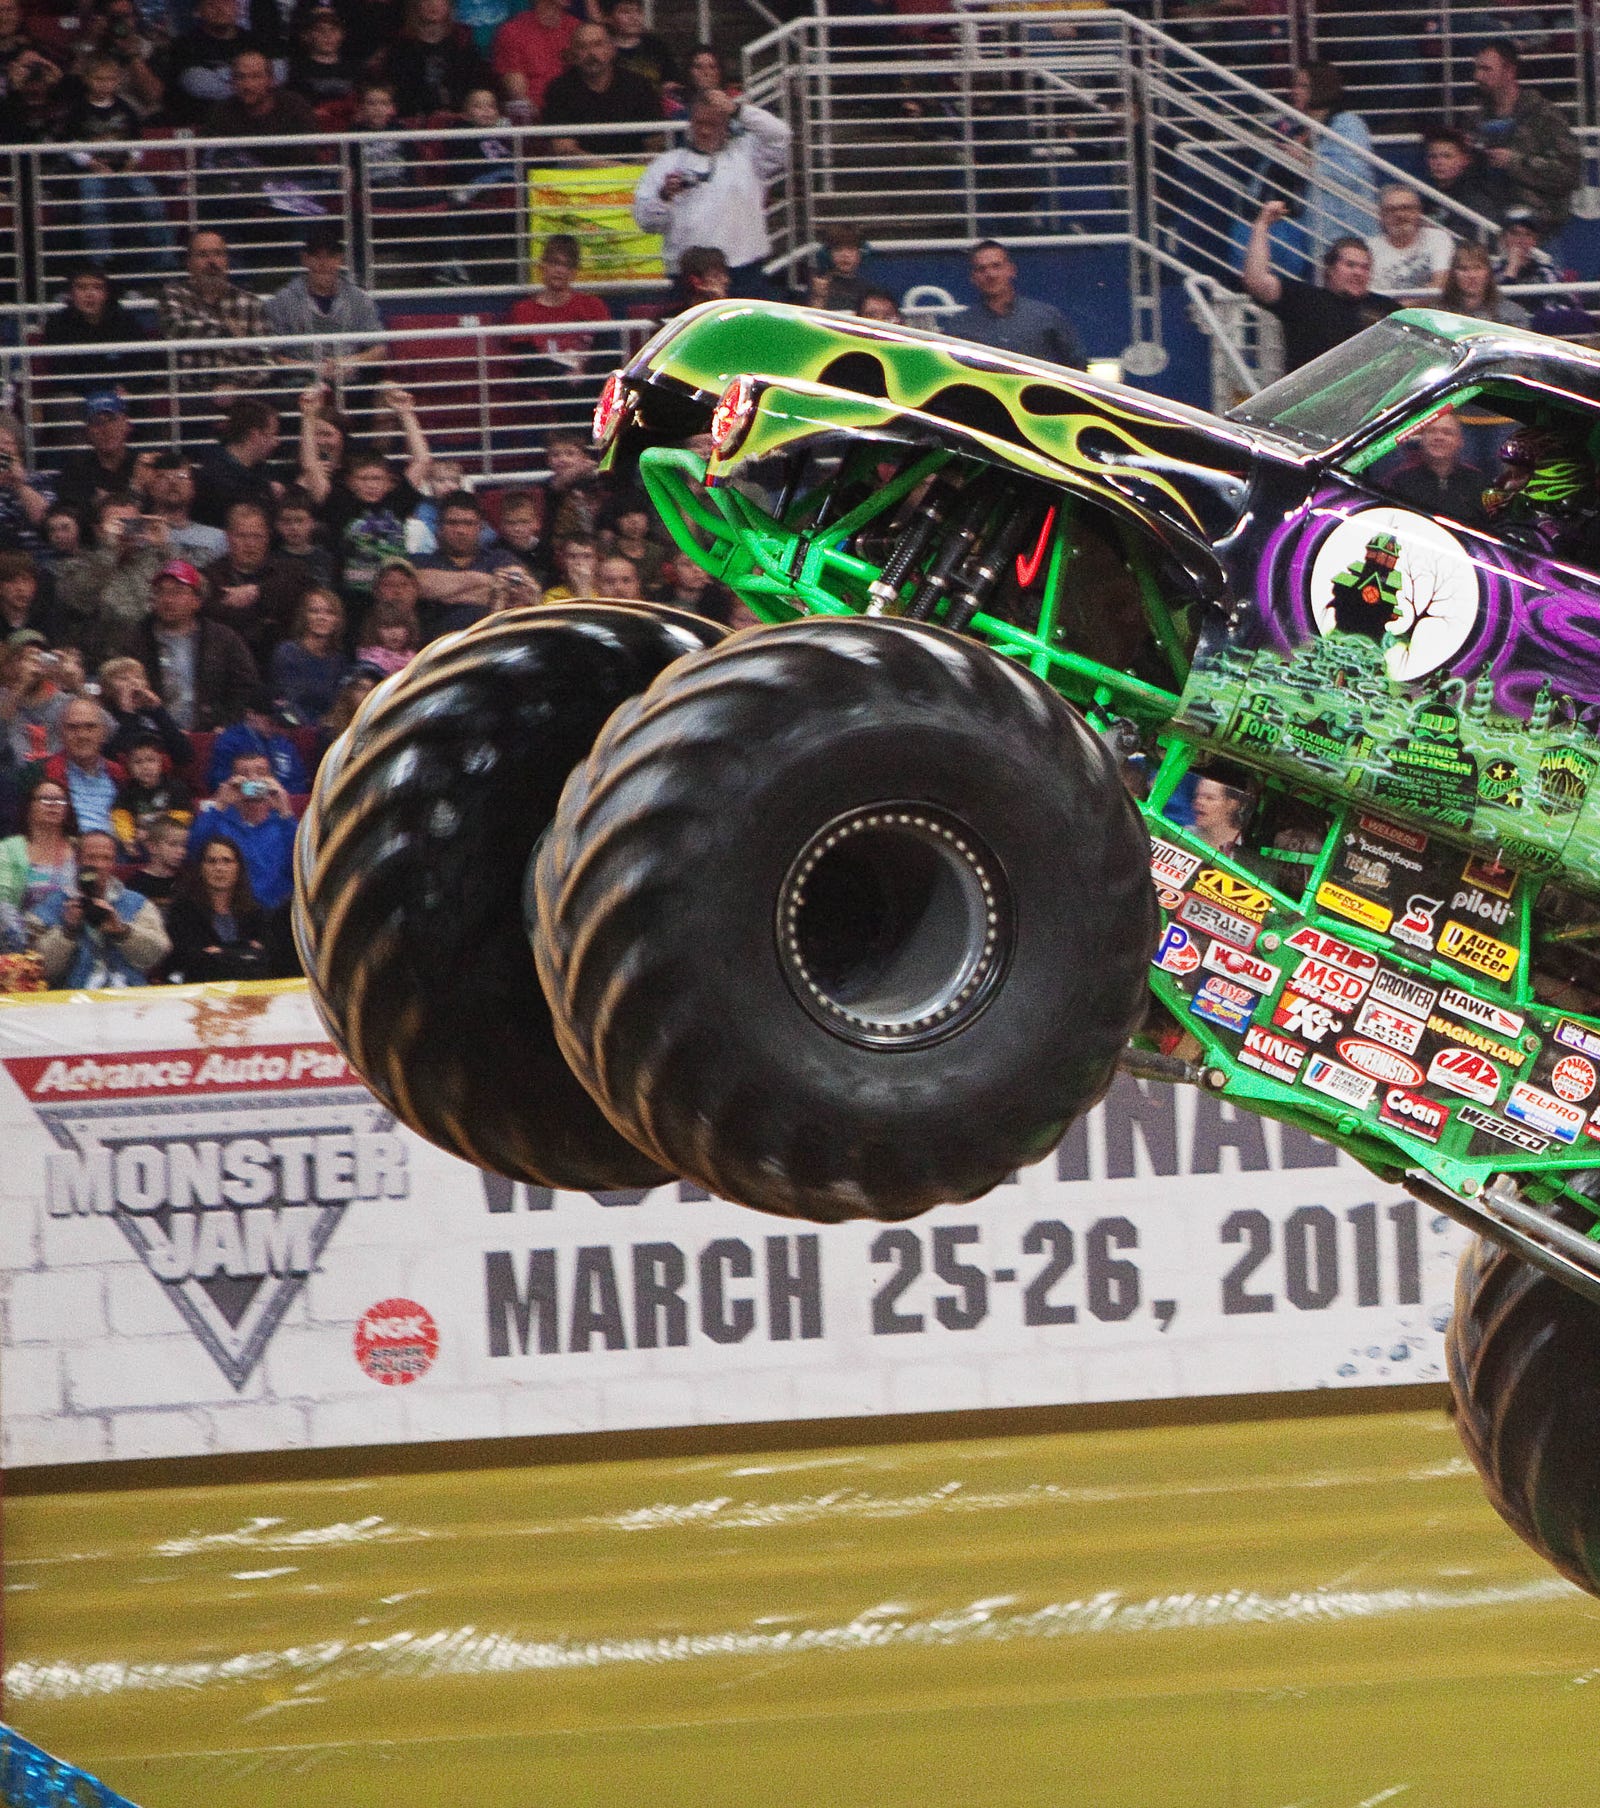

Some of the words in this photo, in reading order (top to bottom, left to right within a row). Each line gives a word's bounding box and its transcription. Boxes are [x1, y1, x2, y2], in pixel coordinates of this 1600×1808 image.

[1287, 723, 1344, 753] MAXIMUM
[1408, 741, 1458, 759] DENNIS
[1387, 750, 1472, 776] ANDERSON
[1540, 748, 1593, 784] AVENGER
[1370, 821, 1417, 846] WELDERS
[1193, 881, 1238, 912] MECHANIX
[1237, 904, 1266, 924] WEAR
[1323, 887, 1365, 909] ENERGY
[1451, 889, 1510, 924] piloti
[1189, 900, 1250, 941] DERALE
[1291, 930, 1376, 969] ARP
[1456, 947, 1509, 973] Meter
[1466, 935, 1506, 958] Auto
[1214, 946, 1273, 982] WORLD
[1300, 961, 1363, 1000] MSD
[1293, 980, 1353, 1011] PRO-MAG
[1375, 971, 1434, 1010] CROWER
[1443, 989, 1495, 1021] HAWK
[1283, 997, 1343, 1043] K&N
[1368, 1010, 1418, 1036] FK
[1375, 1024, 1412, 1043] ROD
[1244, 1029, 1304, 1068] KING
[1361, 1027, 1411, 1051] ENDS
[1426, 1014, 1526, 1066] MAGNAFLOW
[35, 1057, 195, 1094] Advance
[194, 1052, 286, 1087] Auto
[288, 1048, 350, 1080] Par
[1335, 1068, 1371, 1087] UNIVERSAL
[1346, 1044, 1414, 1084] POWERMASTER
[1437, 1051, 1498, 1088] JAZ
[1561, 1064, 1589, 1084] NGK
[1329, 1081, 1363, 1100] INSTITUTE
[1332, 1074, 1366, 1094] TECHNICAL
[1386, 1089, 1441, 1127] Coan
[1516, 1088, 1579, 1122] FEL-PRO
[46, 1132, 409, 1219] MONSTER
[137, 1207, 325, 1284] JAM
[484, 1233, 825, 1358] MARCH
[869, 1215, 1177, 1336] 25-26,
[1219, 1199, 1422, 1316] 2011
[364, 1316, 427, 1341] NGK
